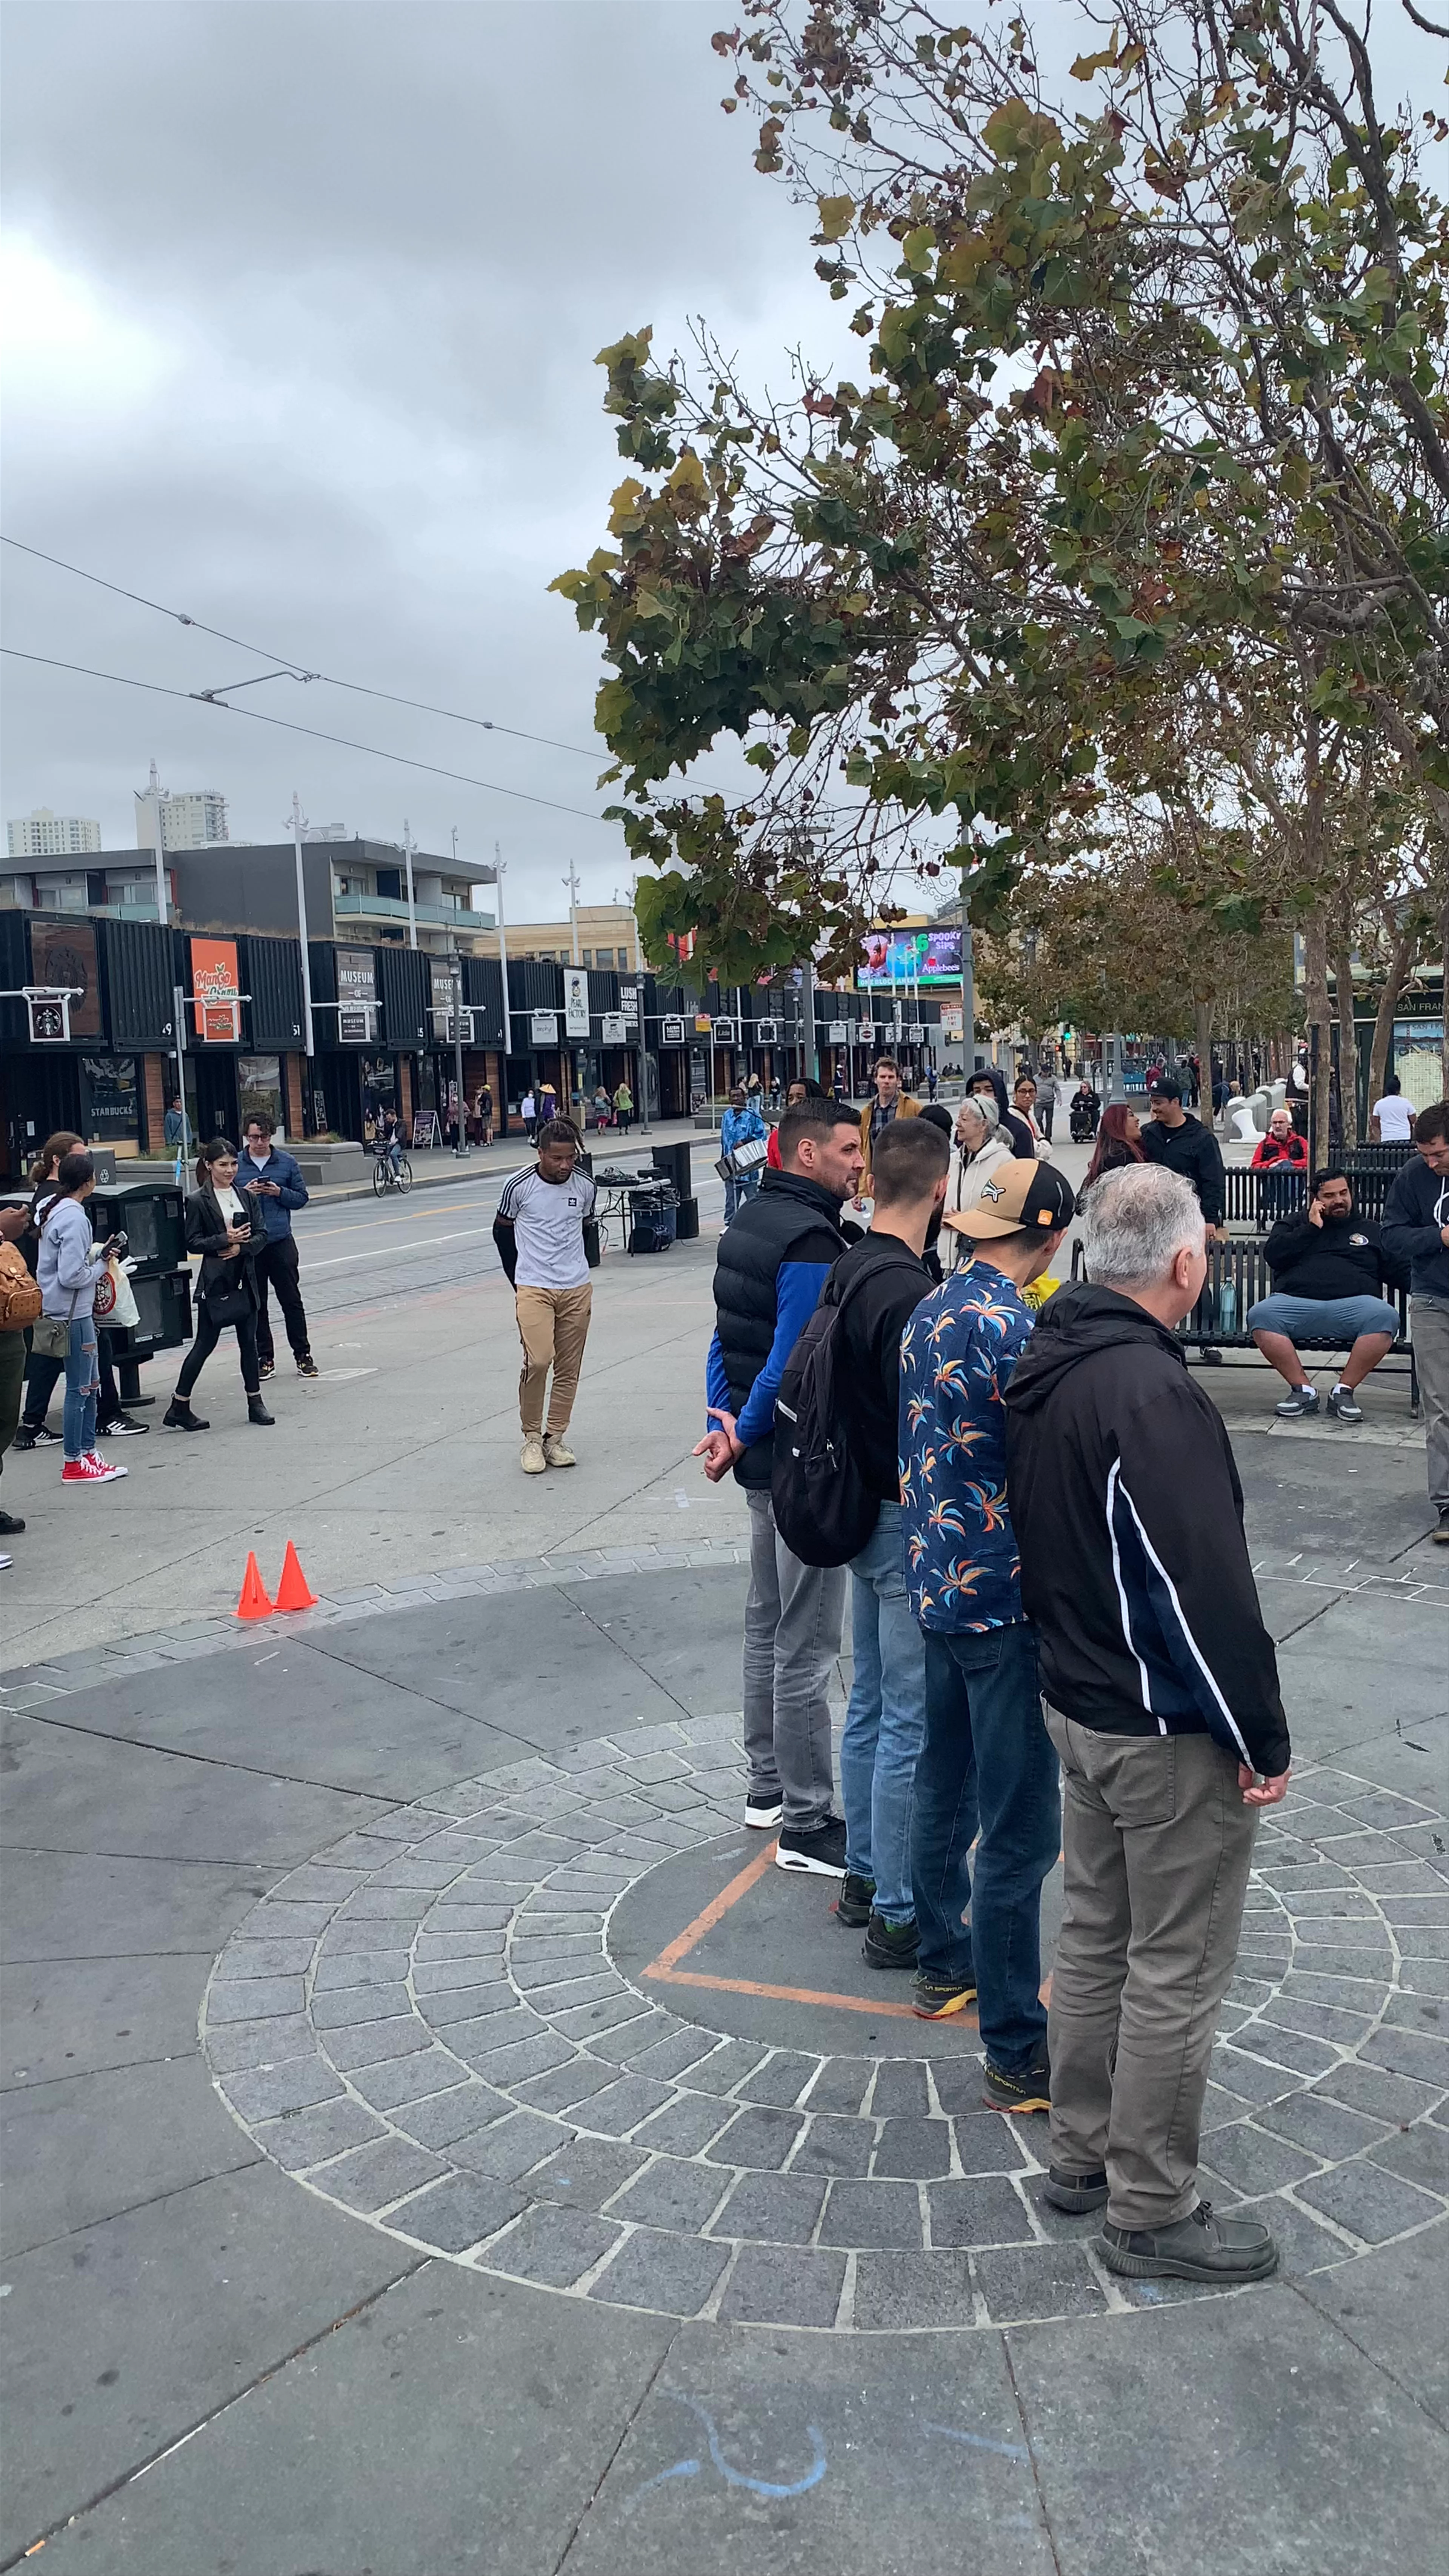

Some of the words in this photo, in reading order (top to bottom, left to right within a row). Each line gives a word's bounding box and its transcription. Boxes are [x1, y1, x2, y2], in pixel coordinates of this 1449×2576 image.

[194, 969, 231, 990] Mango
[341, 970, 374, 984] MUSEUM
[434, 978, 461, 990] MUSEM
[621, 987, 637, 1000] LUSH
[621, 1000, 638, 1012] FRESH
[1397, 1003, 1416, 1012] SAN
[91, 1106, 132, 1117] STARBUCKS
